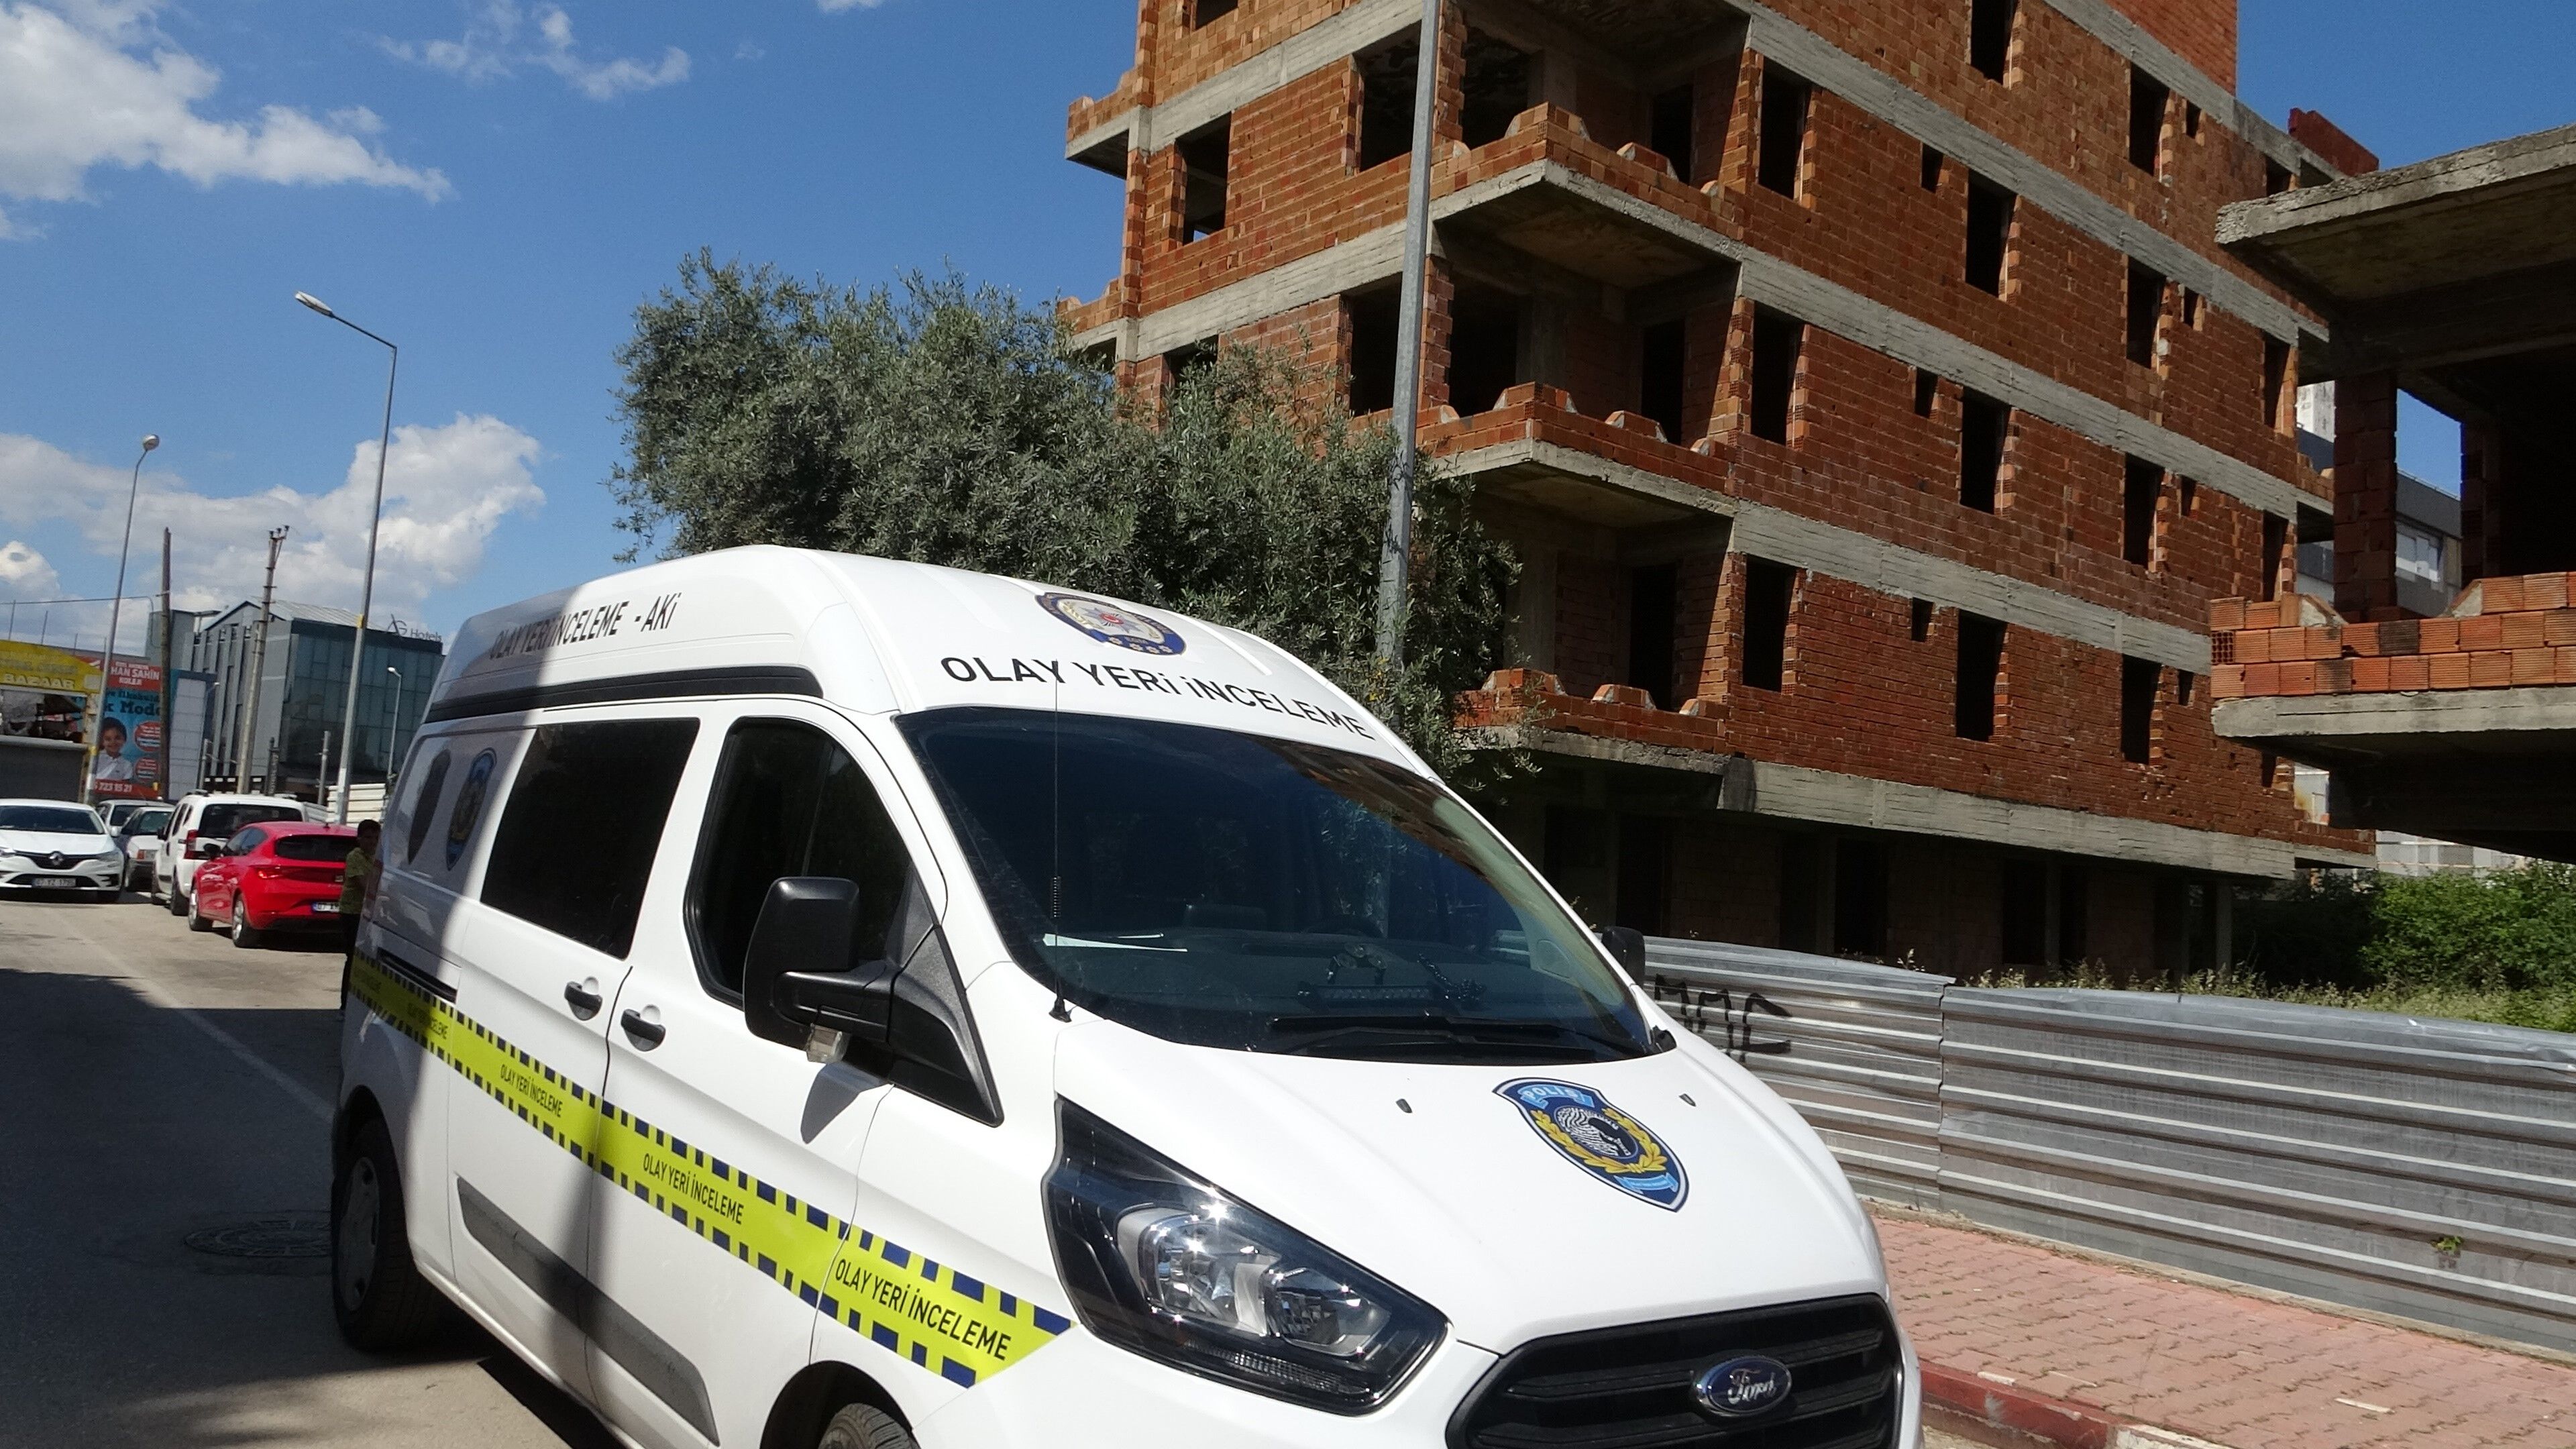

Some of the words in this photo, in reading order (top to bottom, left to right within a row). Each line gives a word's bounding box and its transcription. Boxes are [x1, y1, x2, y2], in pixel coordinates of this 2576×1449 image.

[410, 628, 442, 642] Hotels
[3, 673, 75, 690] BAZAAR
[941, 657, 1066, 684] OLAY
[643, 1152, 667, 1181] OLAY
[669, 1166, 690, 1195] YERİ
[690, 1174, 744, 1225] İNCELEME
[835, 1258, 872, 1294] OLAY
[872, 1275, 910, 1313] YERİ
[908, 1288, 1012, 1361] İNCELEME
[1727, 1368, 1778, 1405] Ford
